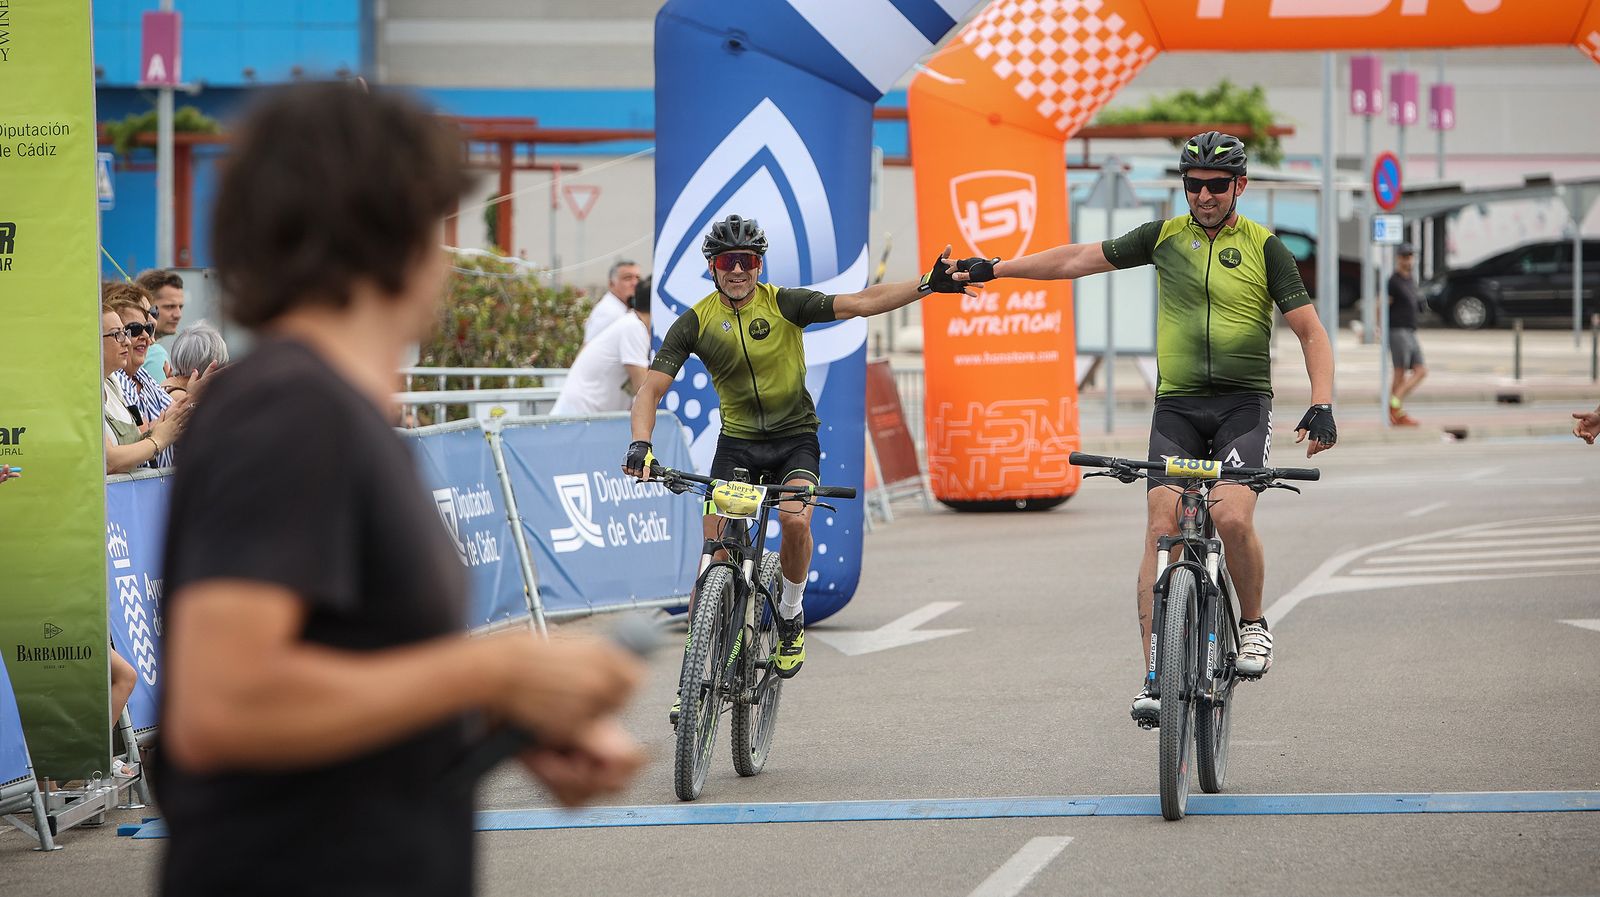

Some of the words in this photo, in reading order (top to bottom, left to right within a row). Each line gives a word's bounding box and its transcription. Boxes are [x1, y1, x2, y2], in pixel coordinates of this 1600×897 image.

[147, 54, 166, 80] A
[0, 122, 70, 140] iputación
[17, 142, 57, 157] Cádiz
[1006, 290, 1047, 311] ARE
[947, 310, 1062, 337] NUTRITION!
[452, 483, 496, 525] Diputación
[607, 515, 628, 547] de
[627, 511, 672, 545] Cádiz
[467, 534, 480, 567] de
[475, 530, 501, 564] Cádiz
[16, 644, 92, 662] BARBADILLO
